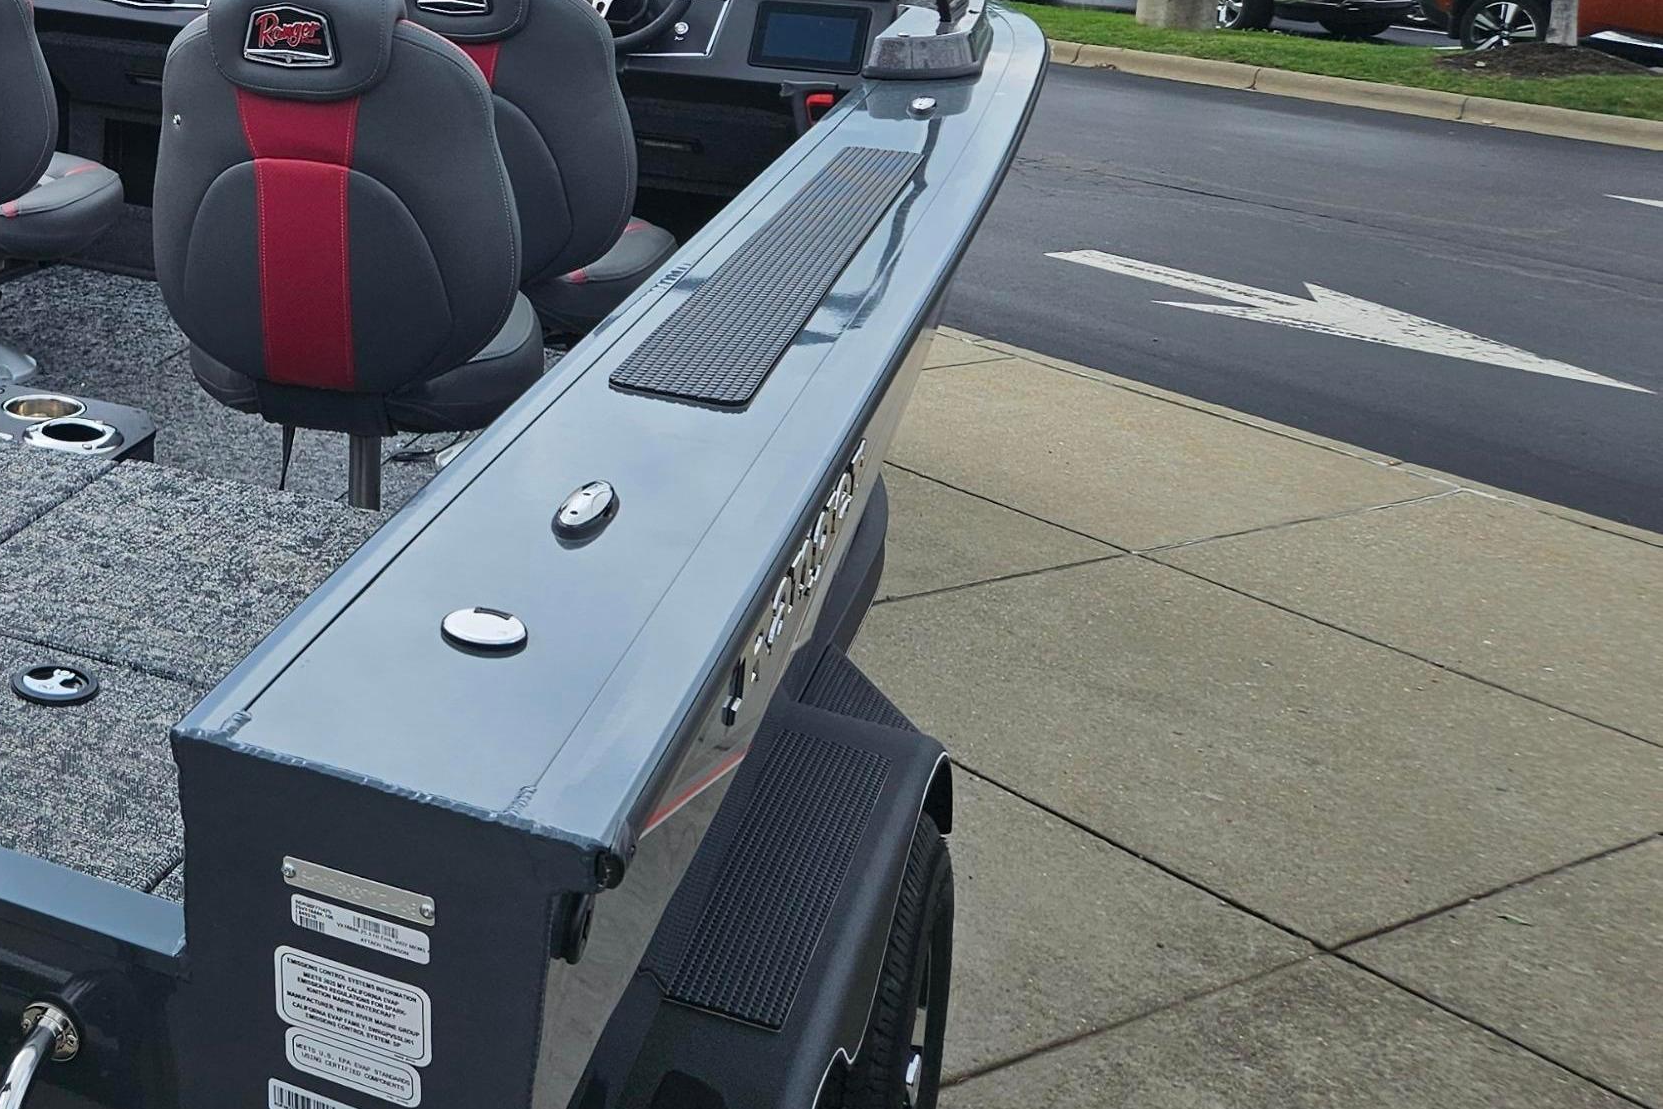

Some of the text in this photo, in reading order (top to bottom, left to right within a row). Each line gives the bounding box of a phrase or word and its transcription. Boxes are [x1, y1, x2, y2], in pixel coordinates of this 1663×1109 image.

[255, 12, 322, 49] Ranger
[319, 966, 347, 981] CONTROL
[348, 976, 375, 991] SYSTEMS
[376, 983, 417, 1003] INFORMATION
[347, 984, 382, 1002] CALIFORNIA
[329, 986, 370, 1005] REGULATIONS
[398, 1026, 421, 1037] GROUP
